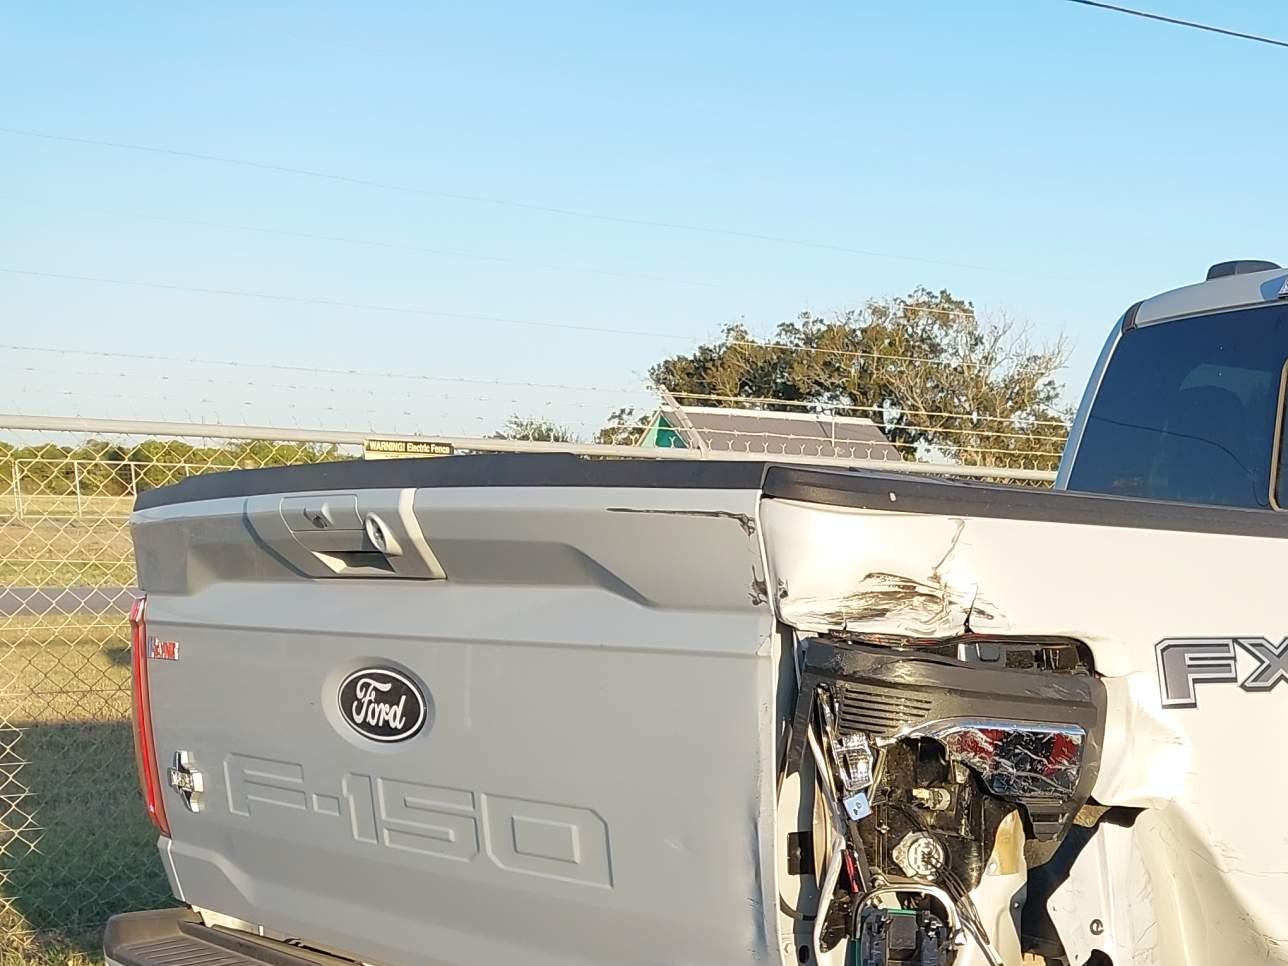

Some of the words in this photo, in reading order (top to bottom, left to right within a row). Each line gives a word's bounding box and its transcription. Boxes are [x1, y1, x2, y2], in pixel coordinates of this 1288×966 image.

[369, 441, 405, 452] WARNING!
[407, 442, 430, 453] Electric
[431, 444, 450, 454] Fence
[352, 678, 407, 730] Ford
[223, 752, 614, 890] F-150
